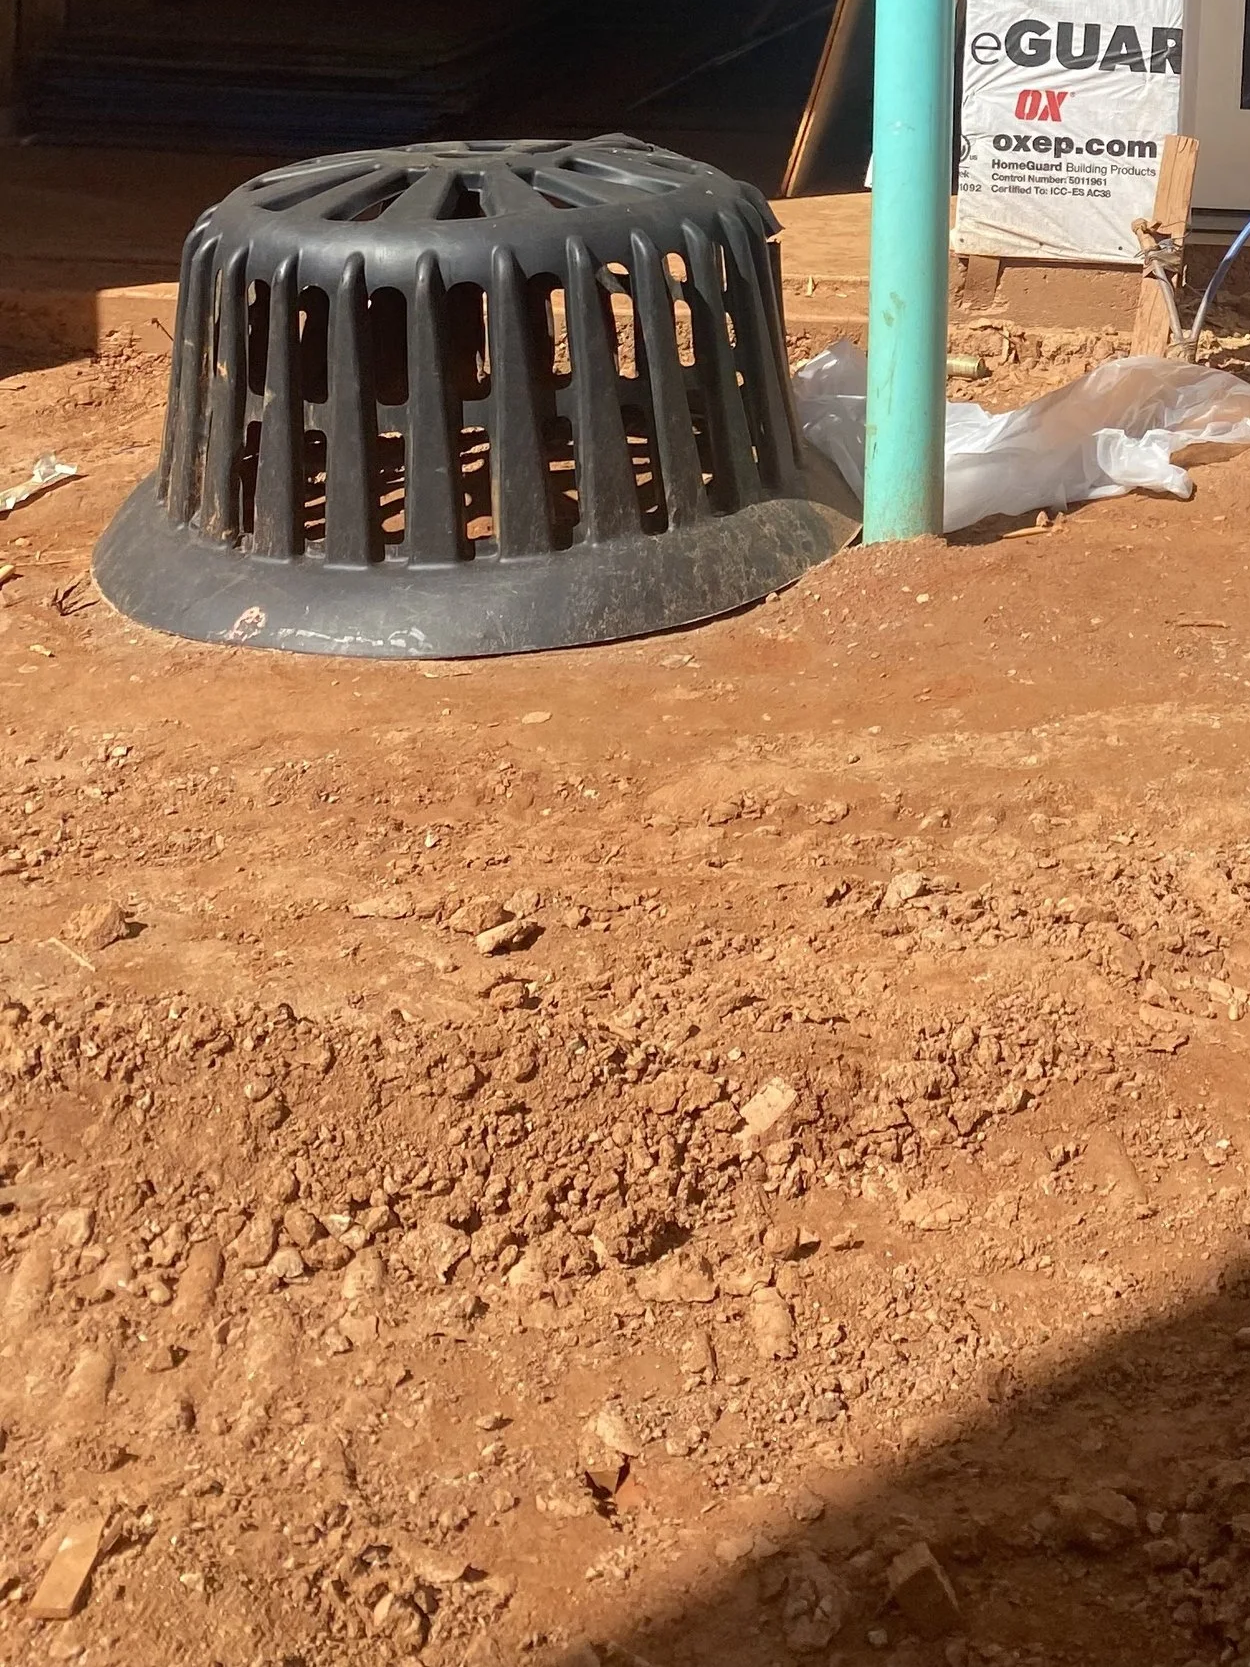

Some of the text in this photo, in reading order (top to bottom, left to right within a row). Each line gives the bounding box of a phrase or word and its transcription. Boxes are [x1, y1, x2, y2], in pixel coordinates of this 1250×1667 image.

[1014, 89, 1068, 122] OX
[992, 134, 1157, 159] oxep.com
[991, 159, 1156, 177] HomeGuard Building Products
[991, 173, 1107, 186] Control Number: 5011961
[991, 185, 1111, 198] Certified To: ICC-ES AC38
